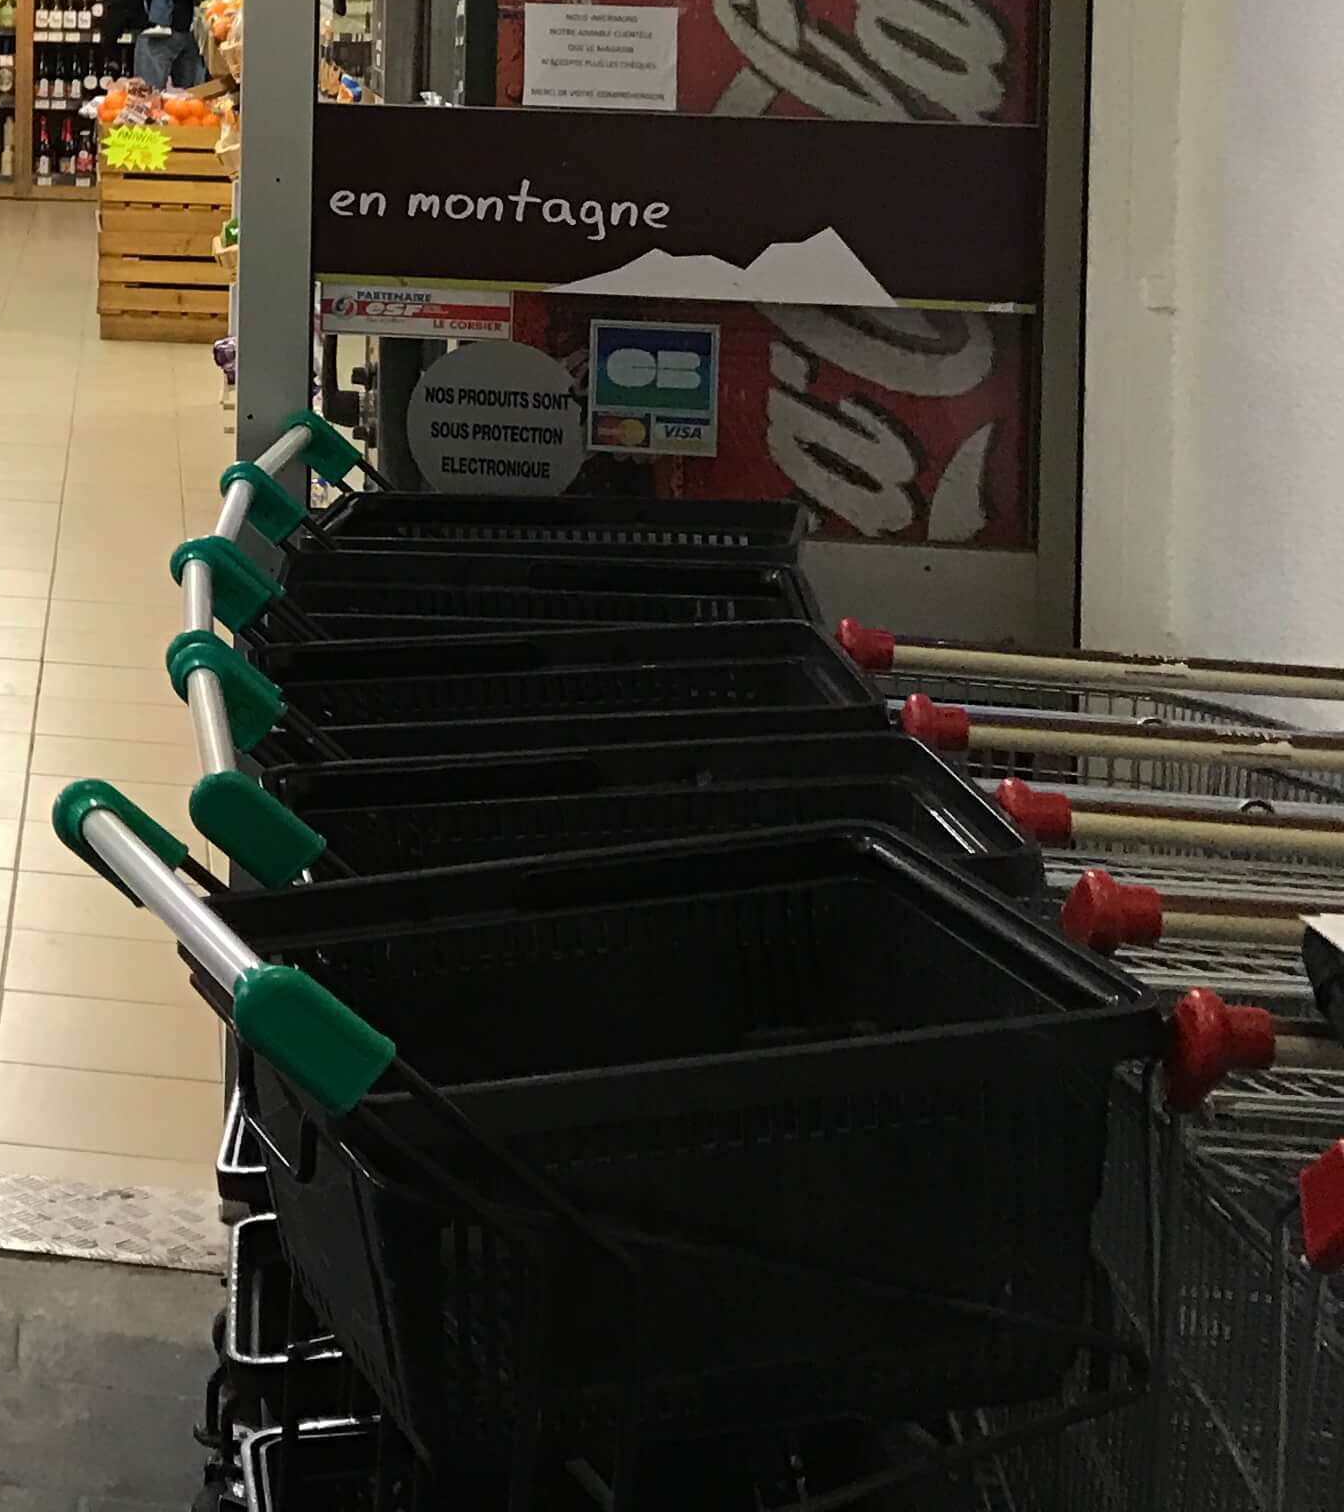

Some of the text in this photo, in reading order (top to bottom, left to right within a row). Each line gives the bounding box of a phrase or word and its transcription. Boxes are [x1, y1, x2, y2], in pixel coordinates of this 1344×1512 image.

[329, 178, 671, 241] en montagne
[356, 290, 432, 303] PARTENAIRE
[433, 320, 503, 332] LE CORBIER
[425, 386, 573, 411] NOS PRODUITS SONT
[431, 421, 563, 445] SOUS PROTECTION
[662, 424, 703, 440] VISA
[441, 456, 551, 479] ELECTRONIQUE
